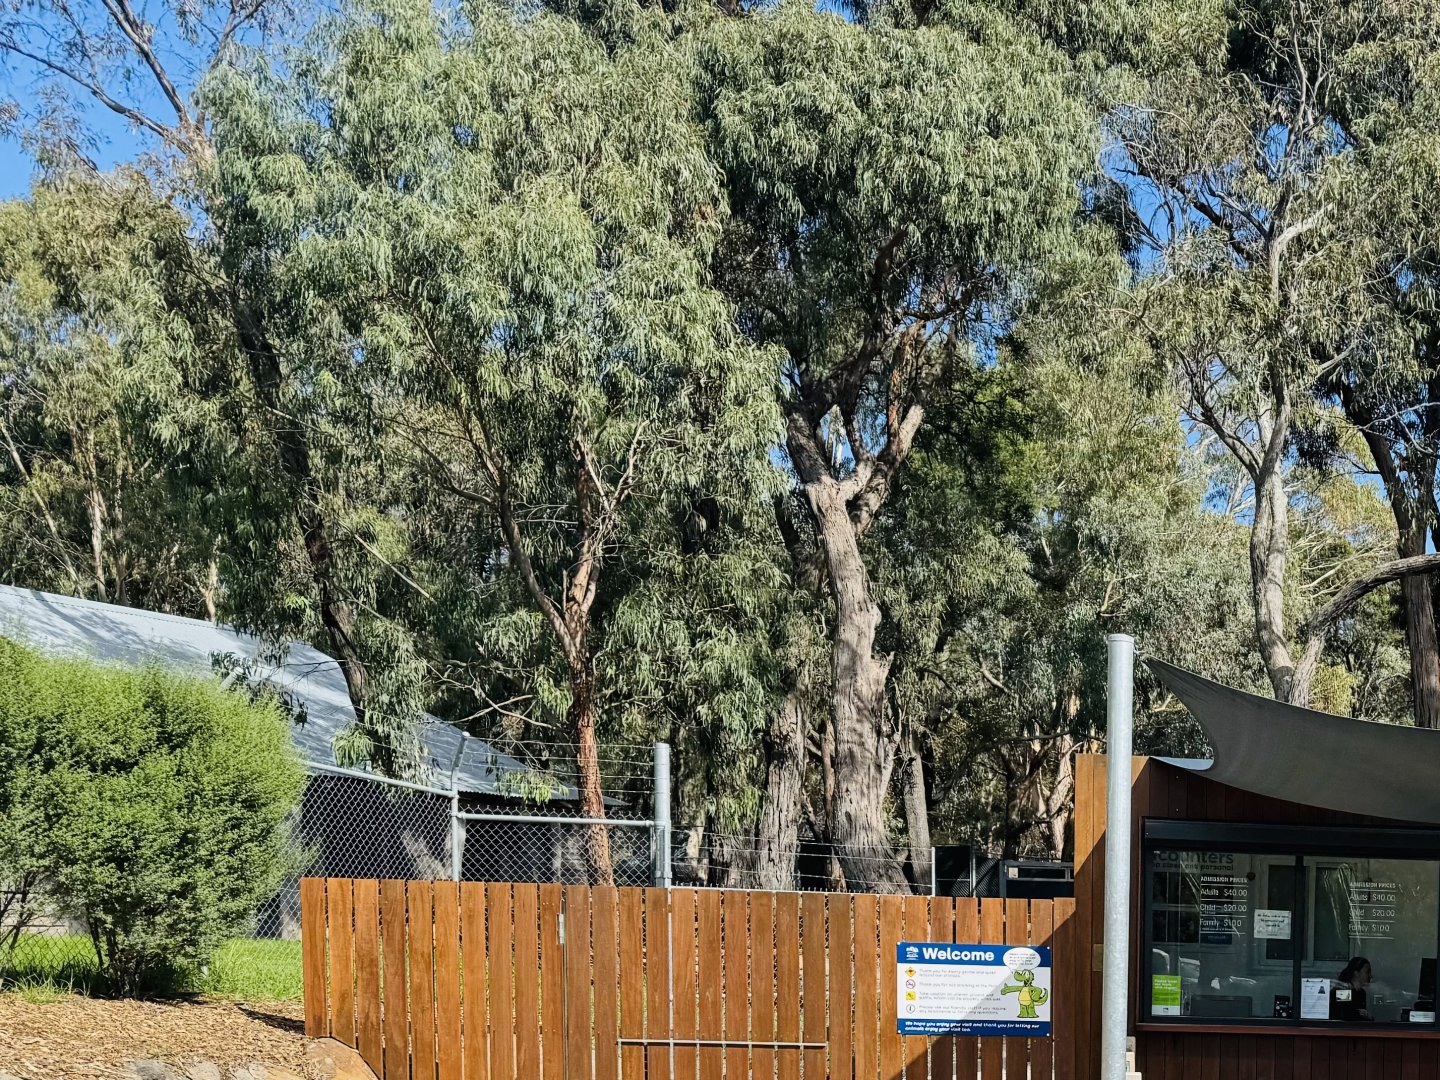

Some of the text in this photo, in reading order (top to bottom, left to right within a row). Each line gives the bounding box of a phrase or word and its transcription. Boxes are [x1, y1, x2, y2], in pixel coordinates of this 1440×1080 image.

[1223, 889, 1248, 897] $40.00
[1372, 893, 1396, 902] $40.00
[1223, 904, 1247, 912] $20.00
[1372, 909, 1395, 917] $20.00
[1200, 919, 1242, 928] Family $100
[1348, 923, 1390, 932] Family $100
[922, 947, 995, 961] Welcome
